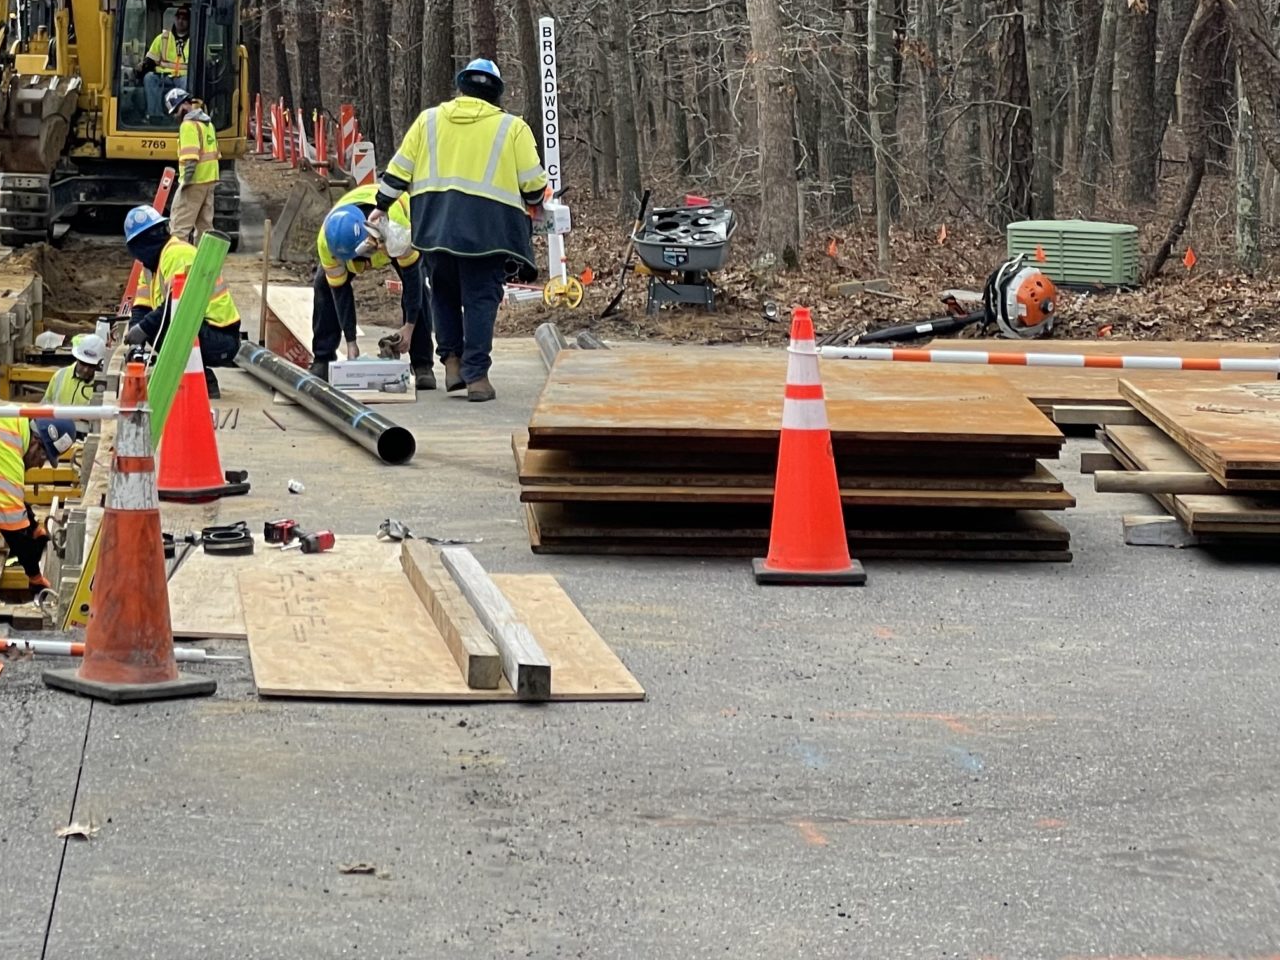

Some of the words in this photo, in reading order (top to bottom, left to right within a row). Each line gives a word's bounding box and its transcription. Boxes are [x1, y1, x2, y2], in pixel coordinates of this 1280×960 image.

[542, 26, 556, 149] BROADWOOD
[141, 140, 166, 149] 2769
[548, 165, 559, 189] CT
